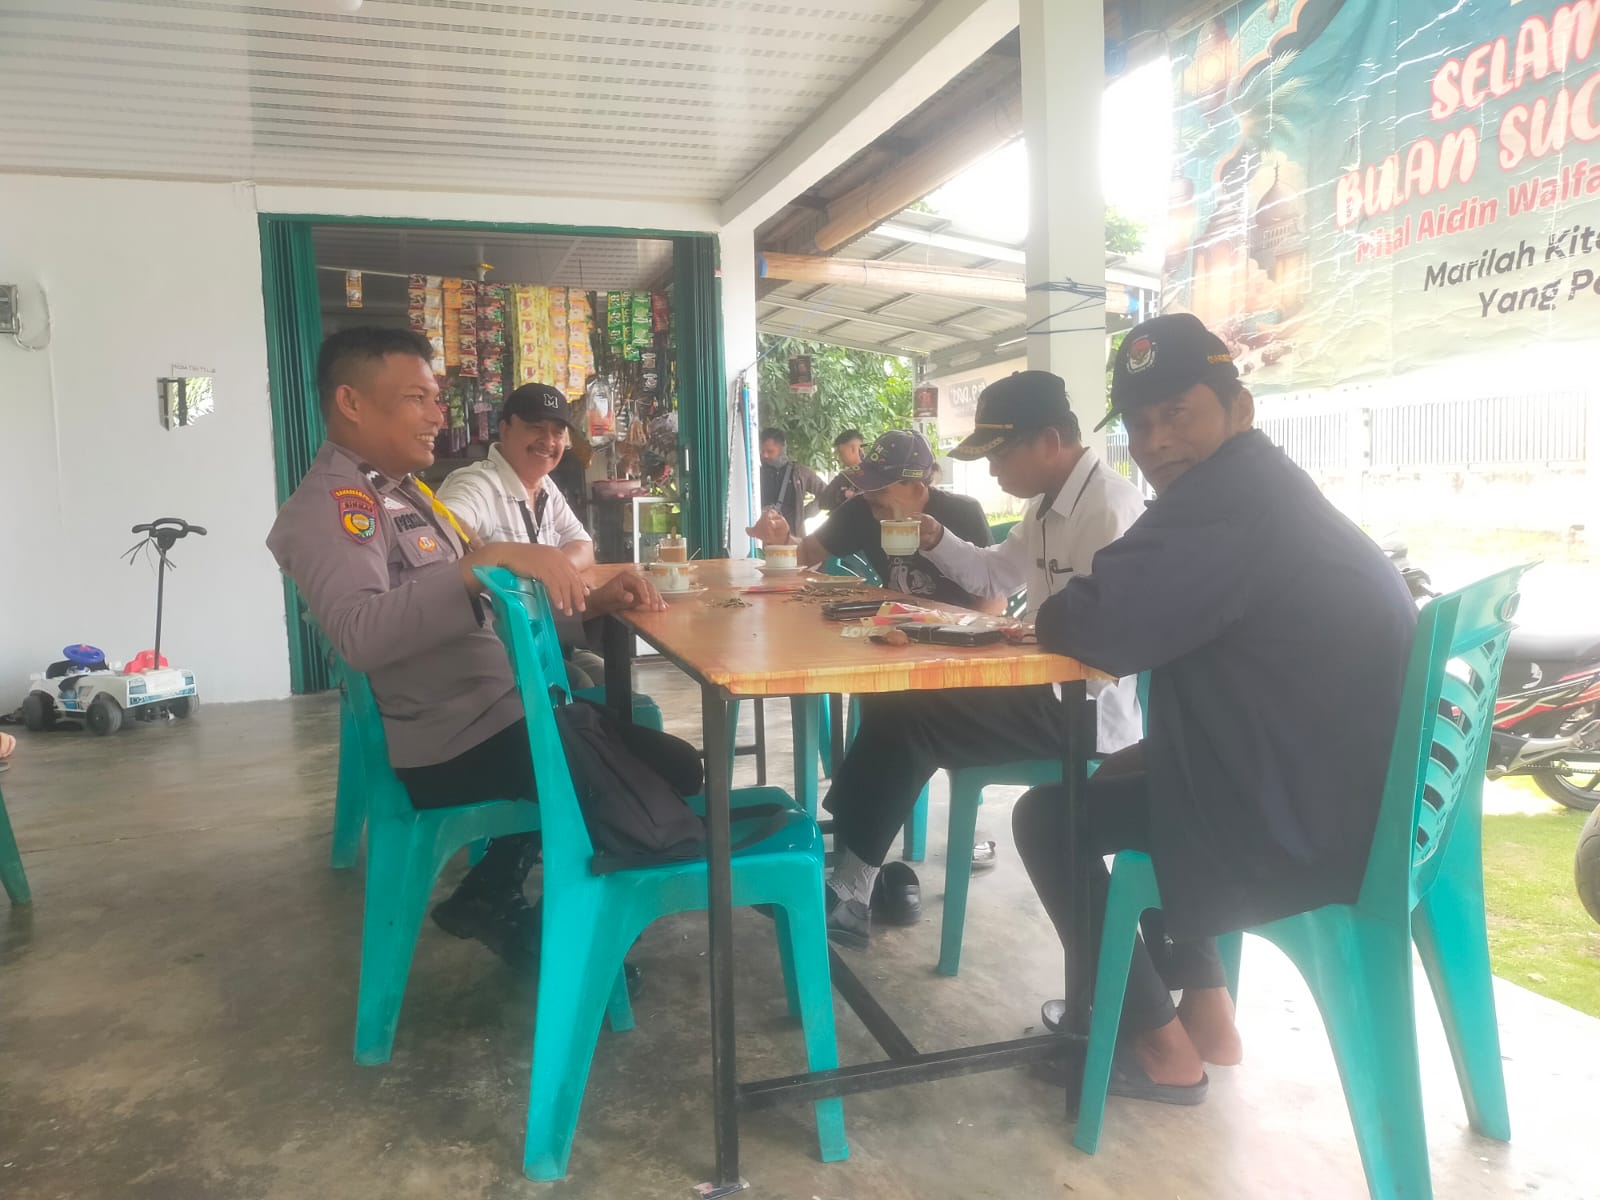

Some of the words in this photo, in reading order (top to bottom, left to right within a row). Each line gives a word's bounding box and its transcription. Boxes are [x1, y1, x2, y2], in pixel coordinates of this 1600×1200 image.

[1336, 125, 1478, 229] BULAN
[1416, 196, 1498, 244] Aidin
[1424, 240, 1536, 291] Marilah
[1479, 278, 1562, 318] Yang
[543, 393, 559, 409] M
